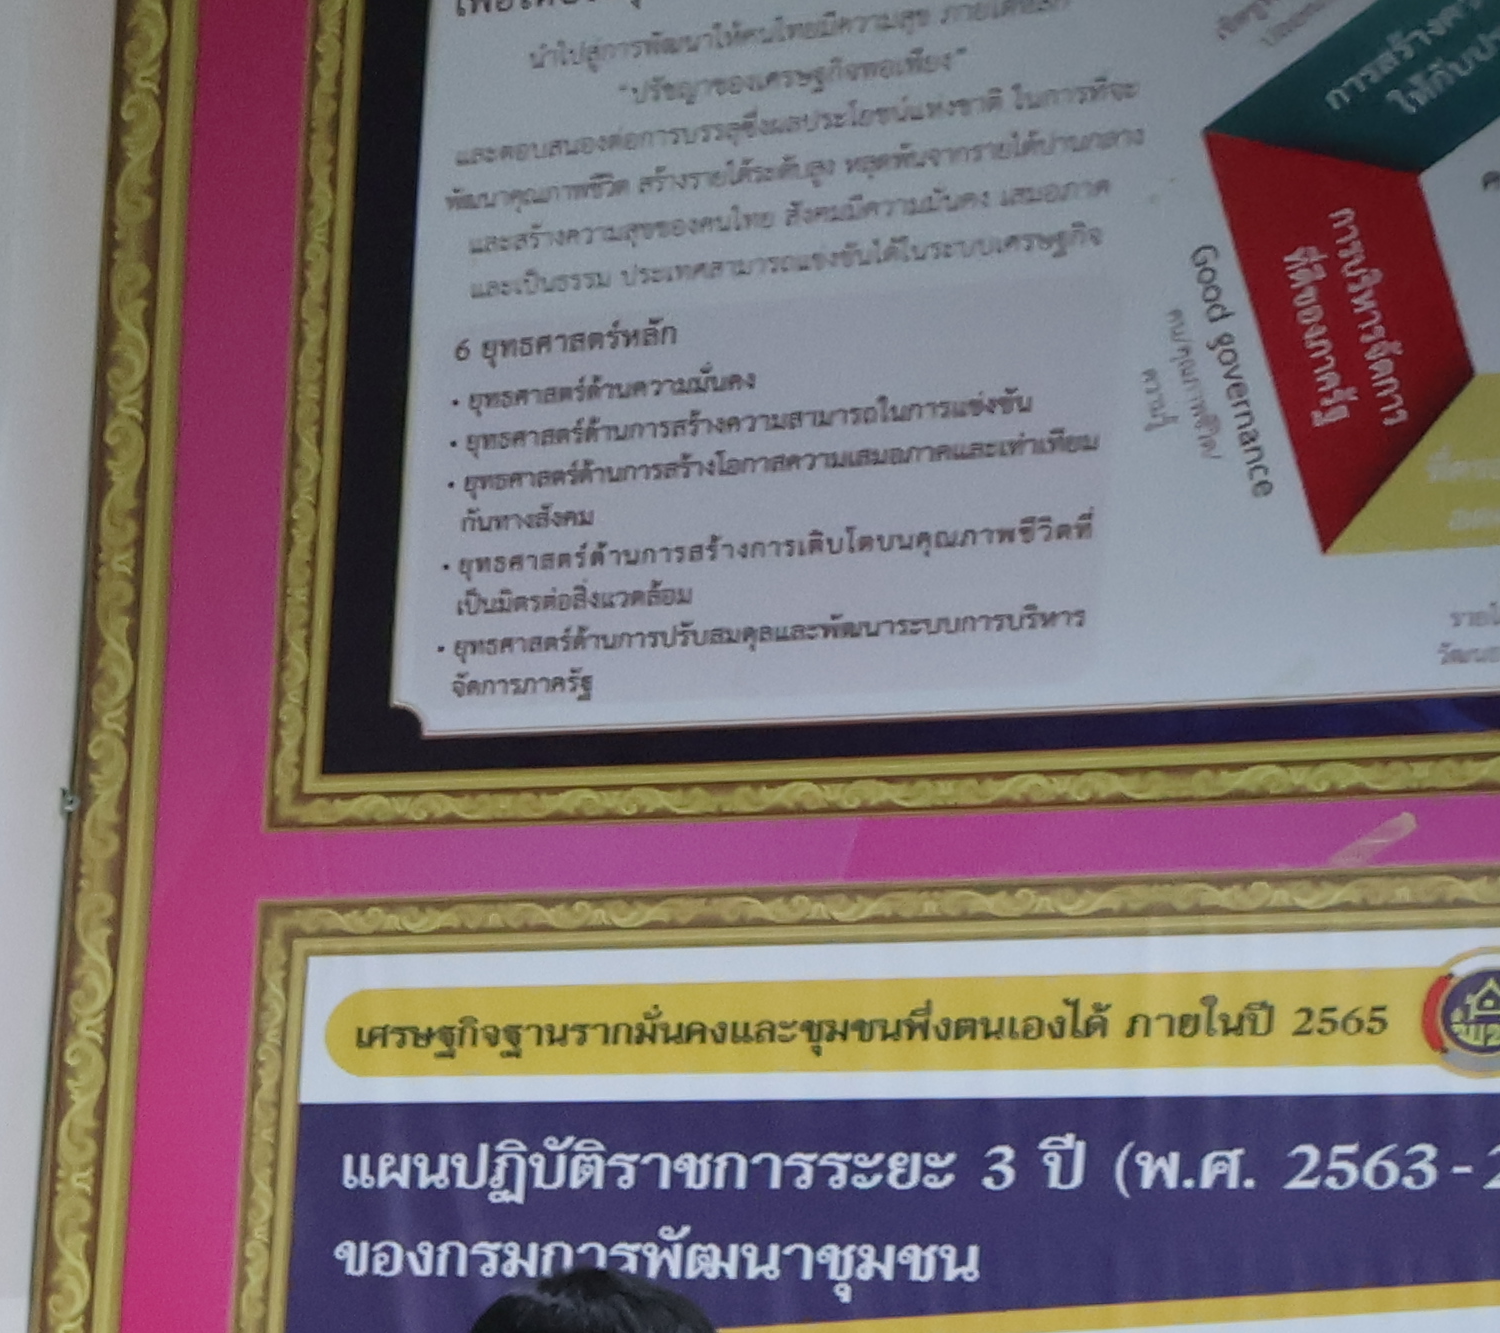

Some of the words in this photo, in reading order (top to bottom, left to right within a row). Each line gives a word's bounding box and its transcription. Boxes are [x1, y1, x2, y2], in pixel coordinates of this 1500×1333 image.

[1189, 243, 1236, 324] Good
[454, 336, 472, 362] 6
[481, 317, 679, 369] ยุทธศาสตร์หลัก
[1204, 330, 1274, 499] governance
[1125, 994, 1276, 1040] ภายในปี
[1292, 1004, 1390, 1038] 2565
[341, 1133, 957, 1205] แผนปฏิบัติราชการระยะ
[981, 1144, 1017, 1191] 3
[1037, 1131, 1089, 1191] ปี
[1114, 1140, 1256, 1199] (พ.ศ.
[334, 1224, 980, 1303] ของกรมการพัฒนาชุมชน
